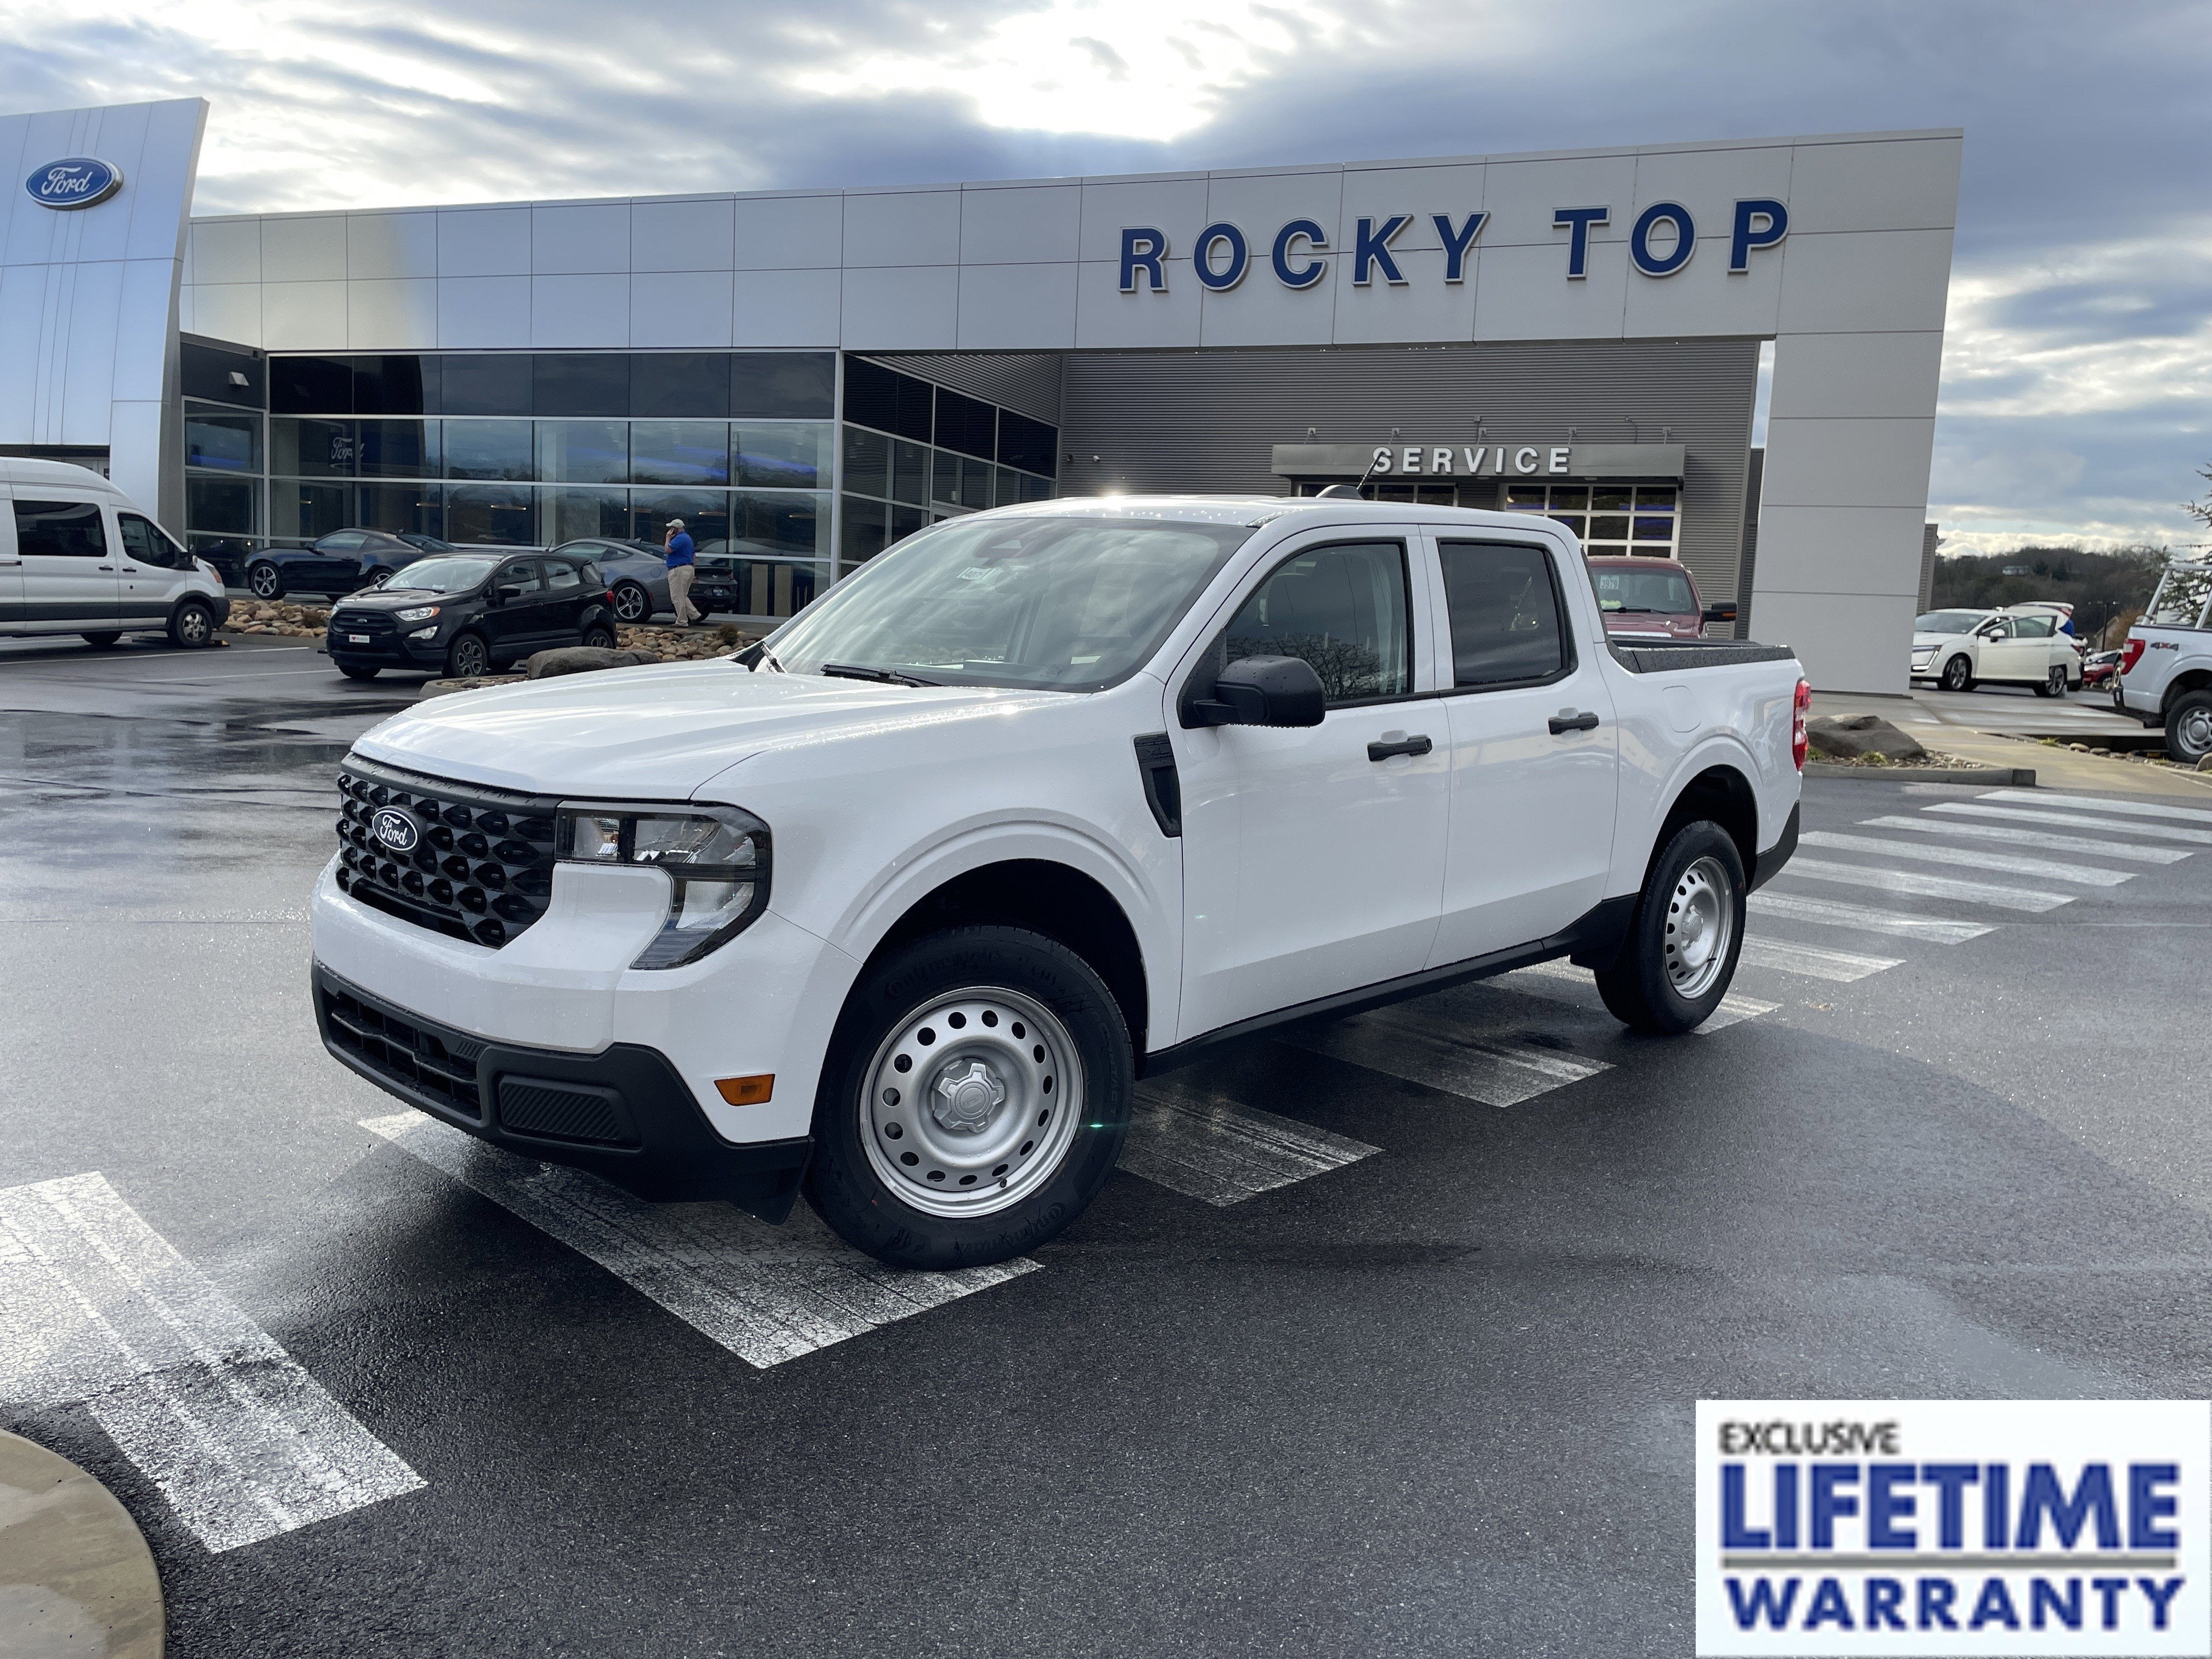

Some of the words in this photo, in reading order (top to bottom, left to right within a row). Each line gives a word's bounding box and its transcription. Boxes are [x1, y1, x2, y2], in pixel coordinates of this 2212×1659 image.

[41, 166, 93, 195] Ford
[1118, 211, 1491, 294] ROCKY
[1552, 197, 1790, 280] TOP
[1373, 447, 1570, 474] SERVICE
[1601, 579, 1618, 589] 3979
[380, 815, 408, 845] Ford
